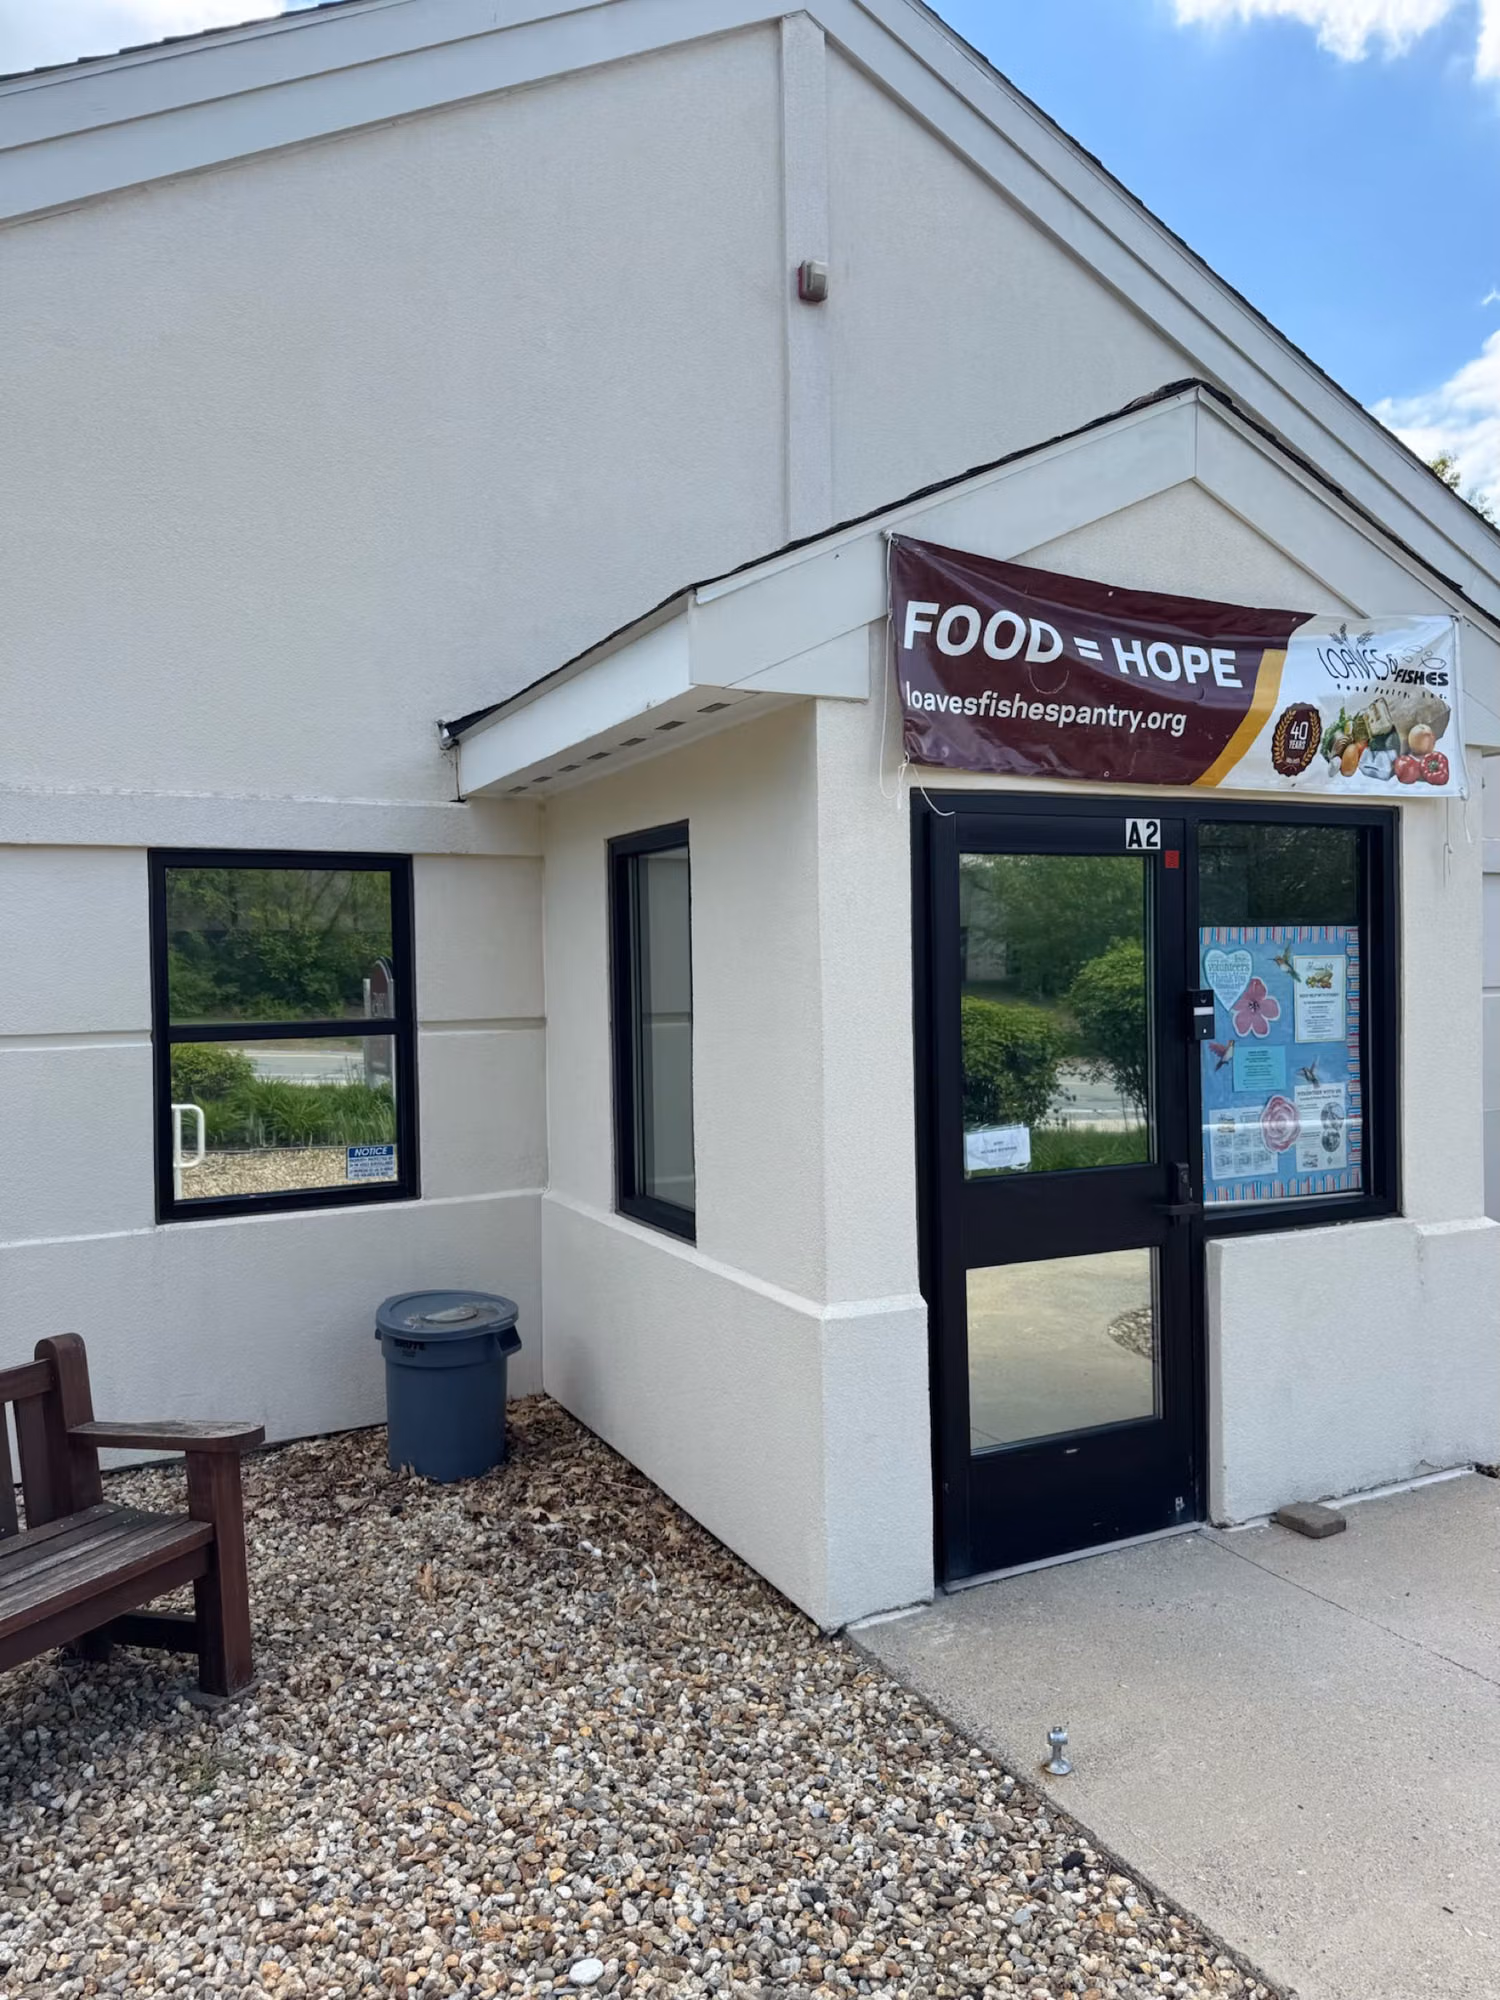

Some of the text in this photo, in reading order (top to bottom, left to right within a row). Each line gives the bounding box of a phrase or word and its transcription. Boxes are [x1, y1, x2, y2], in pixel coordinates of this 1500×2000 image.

[903, 600, 1244, 688] FOOD = HOPE
[1316, 647, 1390, 681] LOAVES
[1393, 668, 1449, 687] FISHES
[904, 680, 1188, 738] loavesfishespantry.org
[1290, 720, 1309, 740] 40
[1288, 740, 1307, 750] YEARS
[1127, 820, 1159, 848] A2
[354, 1146, 388, 1156] NOTICE
